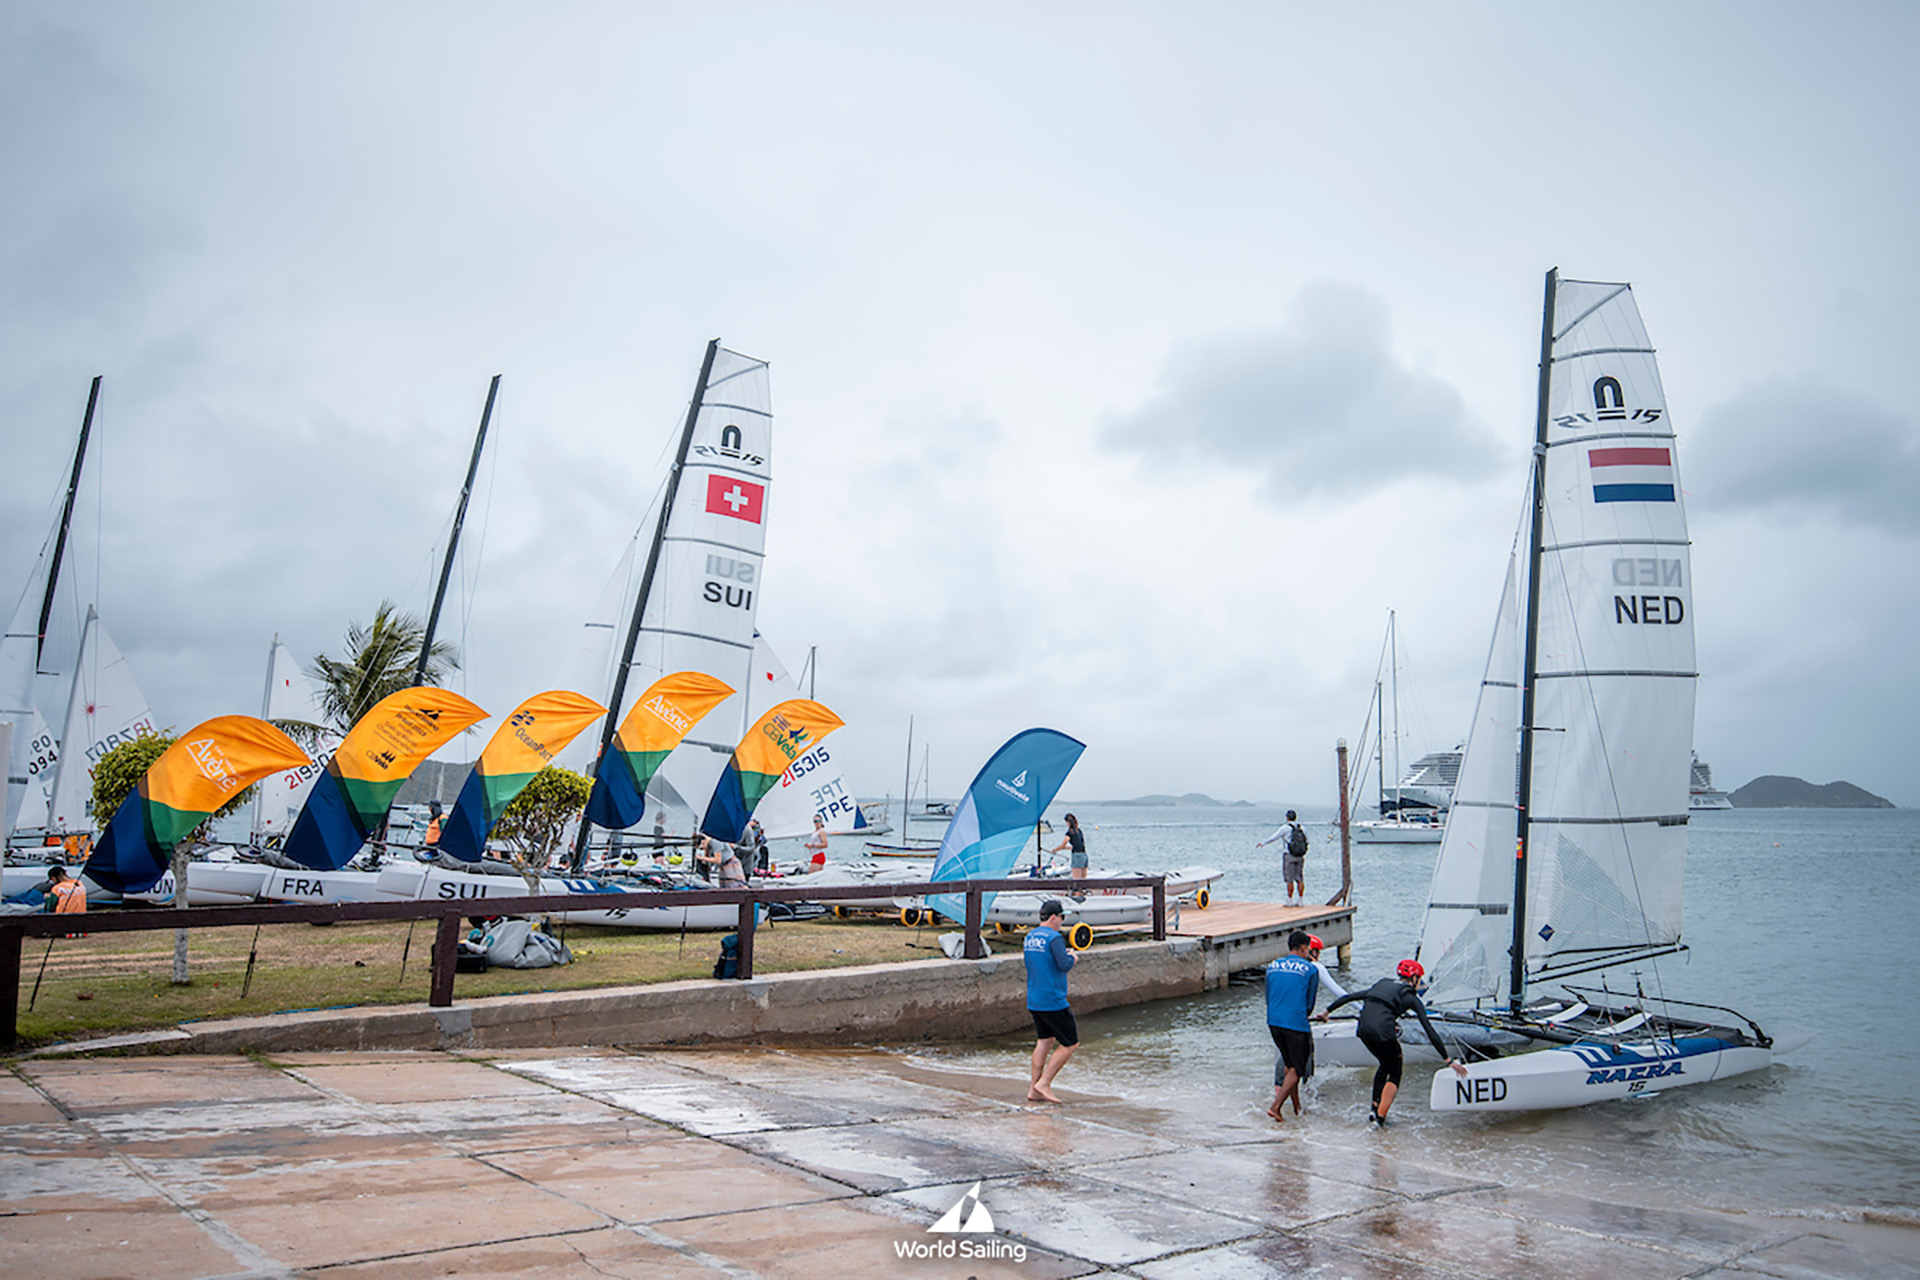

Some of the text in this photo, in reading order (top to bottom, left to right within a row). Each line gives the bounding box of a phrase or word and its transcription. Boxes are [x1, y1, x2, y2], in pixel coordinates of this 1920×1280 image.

[1631, 409, 1663, 424] 15
[742, 453, 764, 466] 15
[703, 582, 753, 611] SUI
[1613, 595, 1685, 625] NED
[646, 695, 688, 731] Avène
[189, 738, 238, 789] Avène
[782, 746, 830, 788] 215315
[817, 795, 854, 822] TPE
[149, 879, 174, 894] UN
[282, 878, 324, 896] FRA
[437, 882, 488, 899] SUI
[1586, 1061, 1686, 1085] NACRA
[1456, 1077, 1508, 1105] NED
[1628, 1081, 1648, 1093] 15
